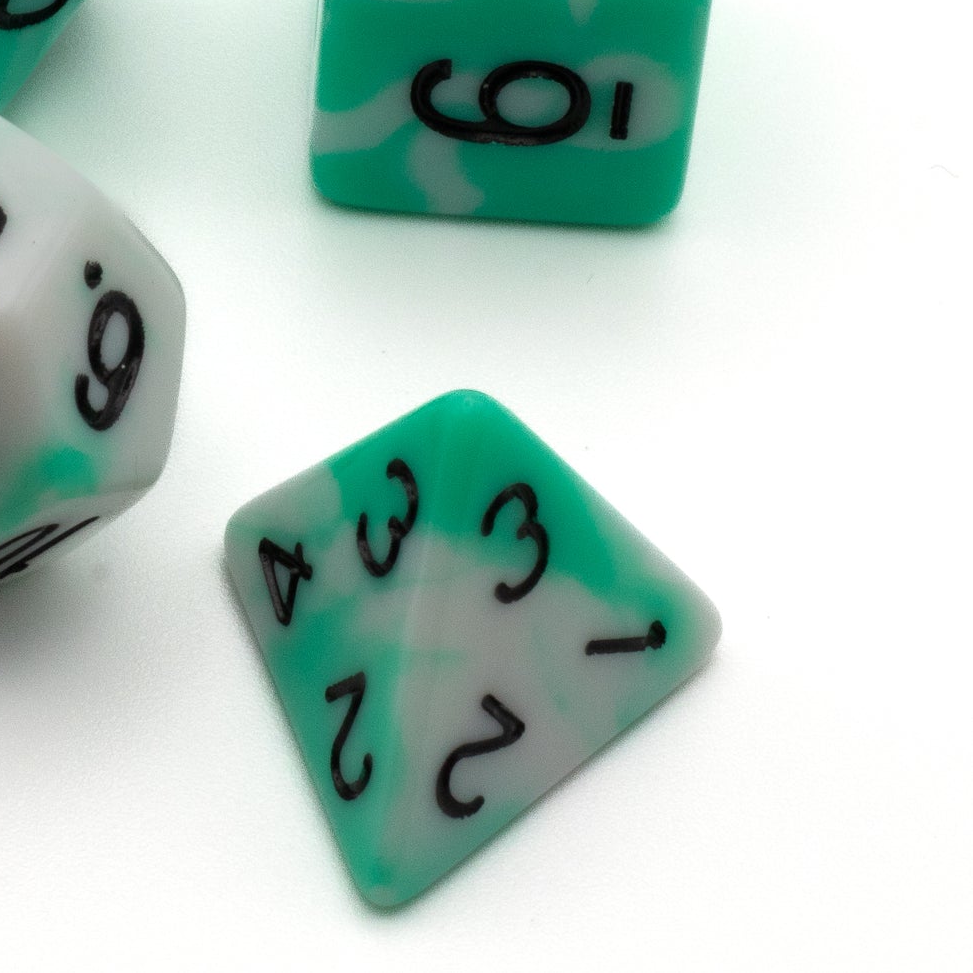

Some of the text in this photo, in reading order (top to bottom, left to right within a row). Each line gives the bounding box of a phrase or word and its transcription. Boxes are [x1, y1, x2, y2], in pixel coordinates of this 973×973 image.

[356, 457, 421, 579] 3
[480, 481, 551, 605] 3
[257, 536, 314, 628] 4
[584, 620, 668, 657] 1
[324, 670, 375, 802] 2
[434, 693, 526, 821] 2
